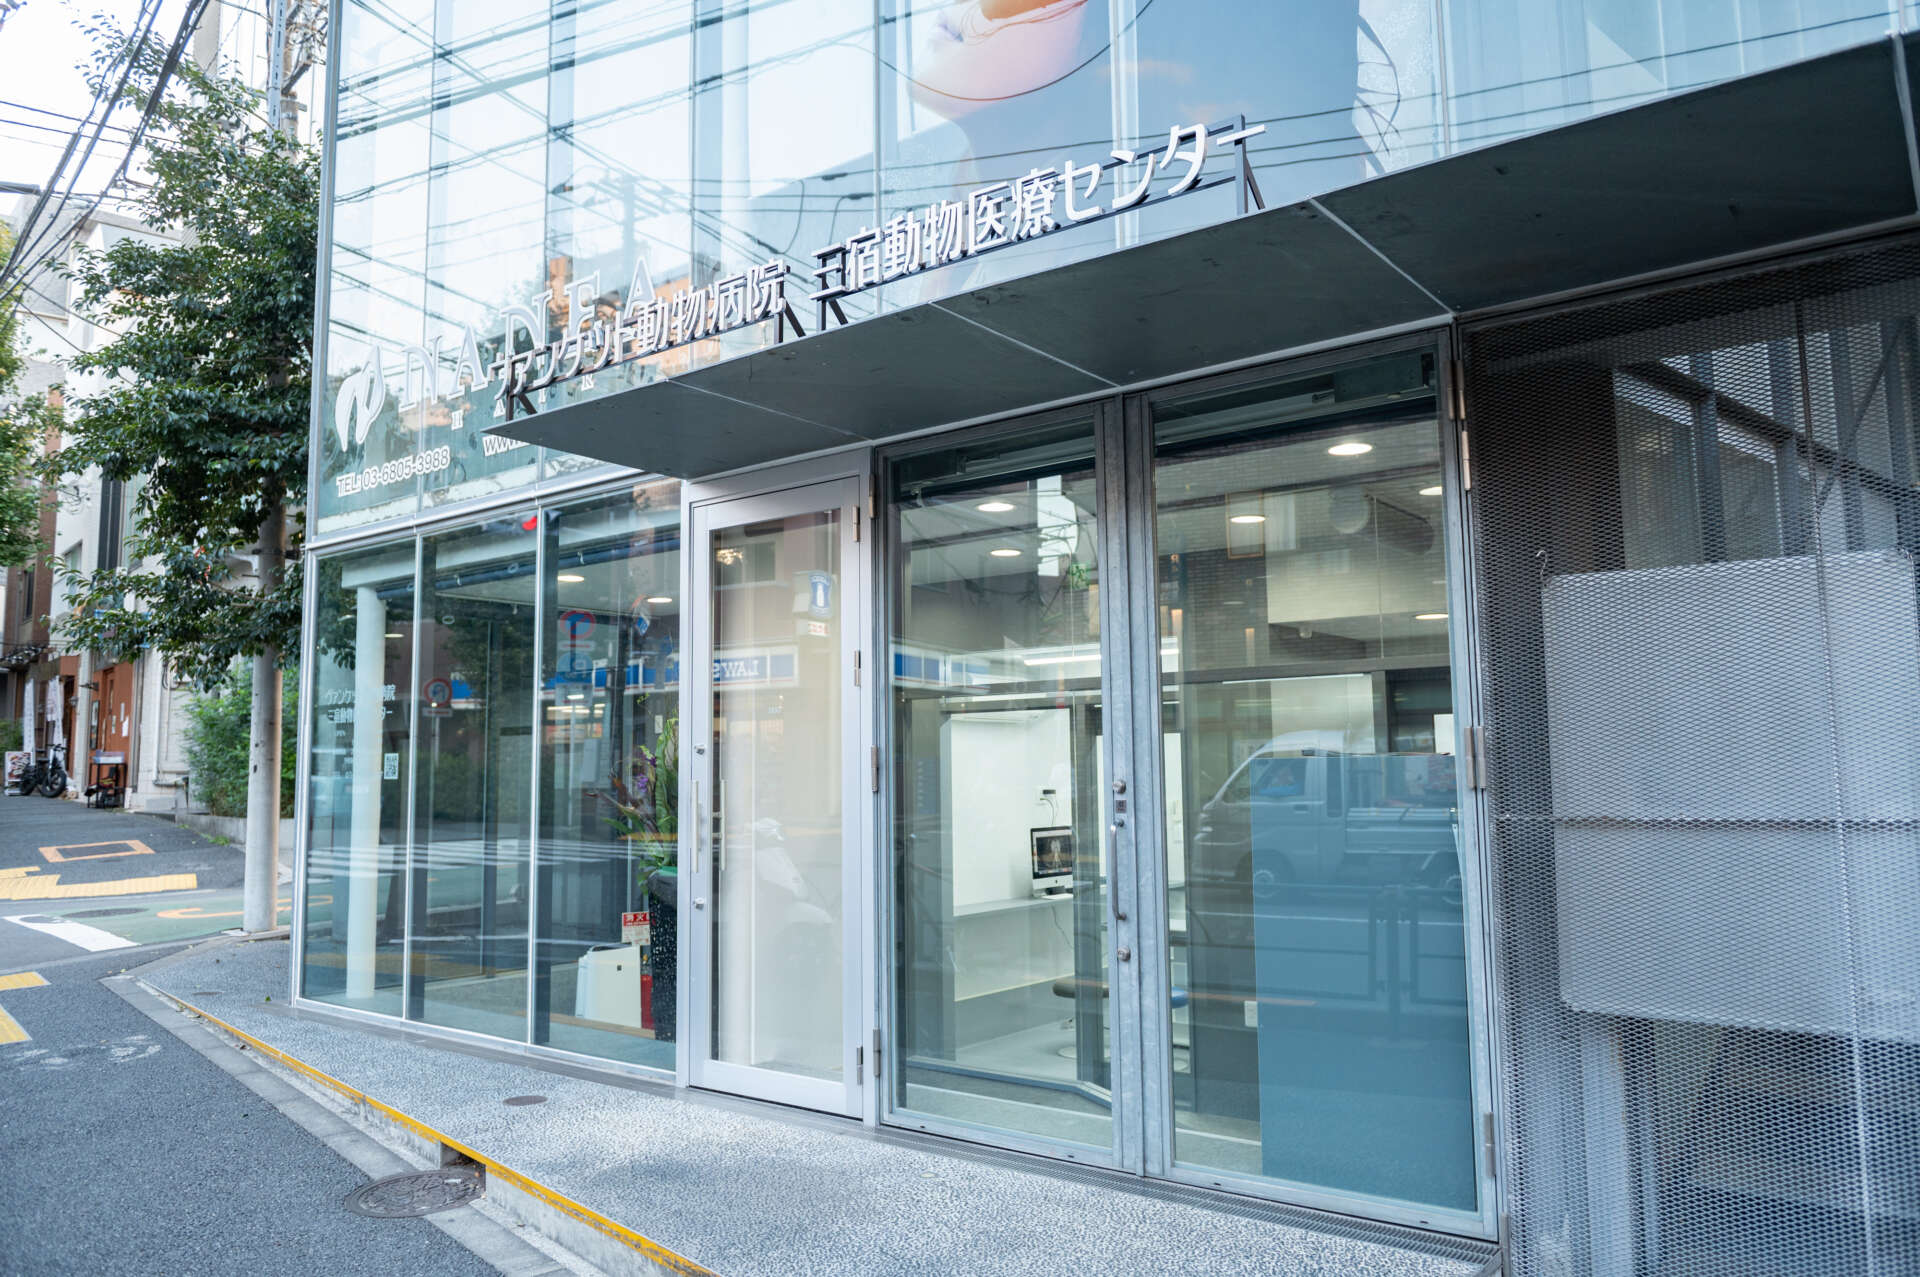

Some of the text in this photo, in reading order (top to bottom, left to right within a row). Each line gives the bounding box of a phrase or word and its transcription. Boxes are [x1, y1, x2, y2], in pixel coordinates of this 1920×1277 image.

[809, 122, 1267, 302] 三宿動物医療センター
[362, 447, 450, 488] 03-6805-3988
